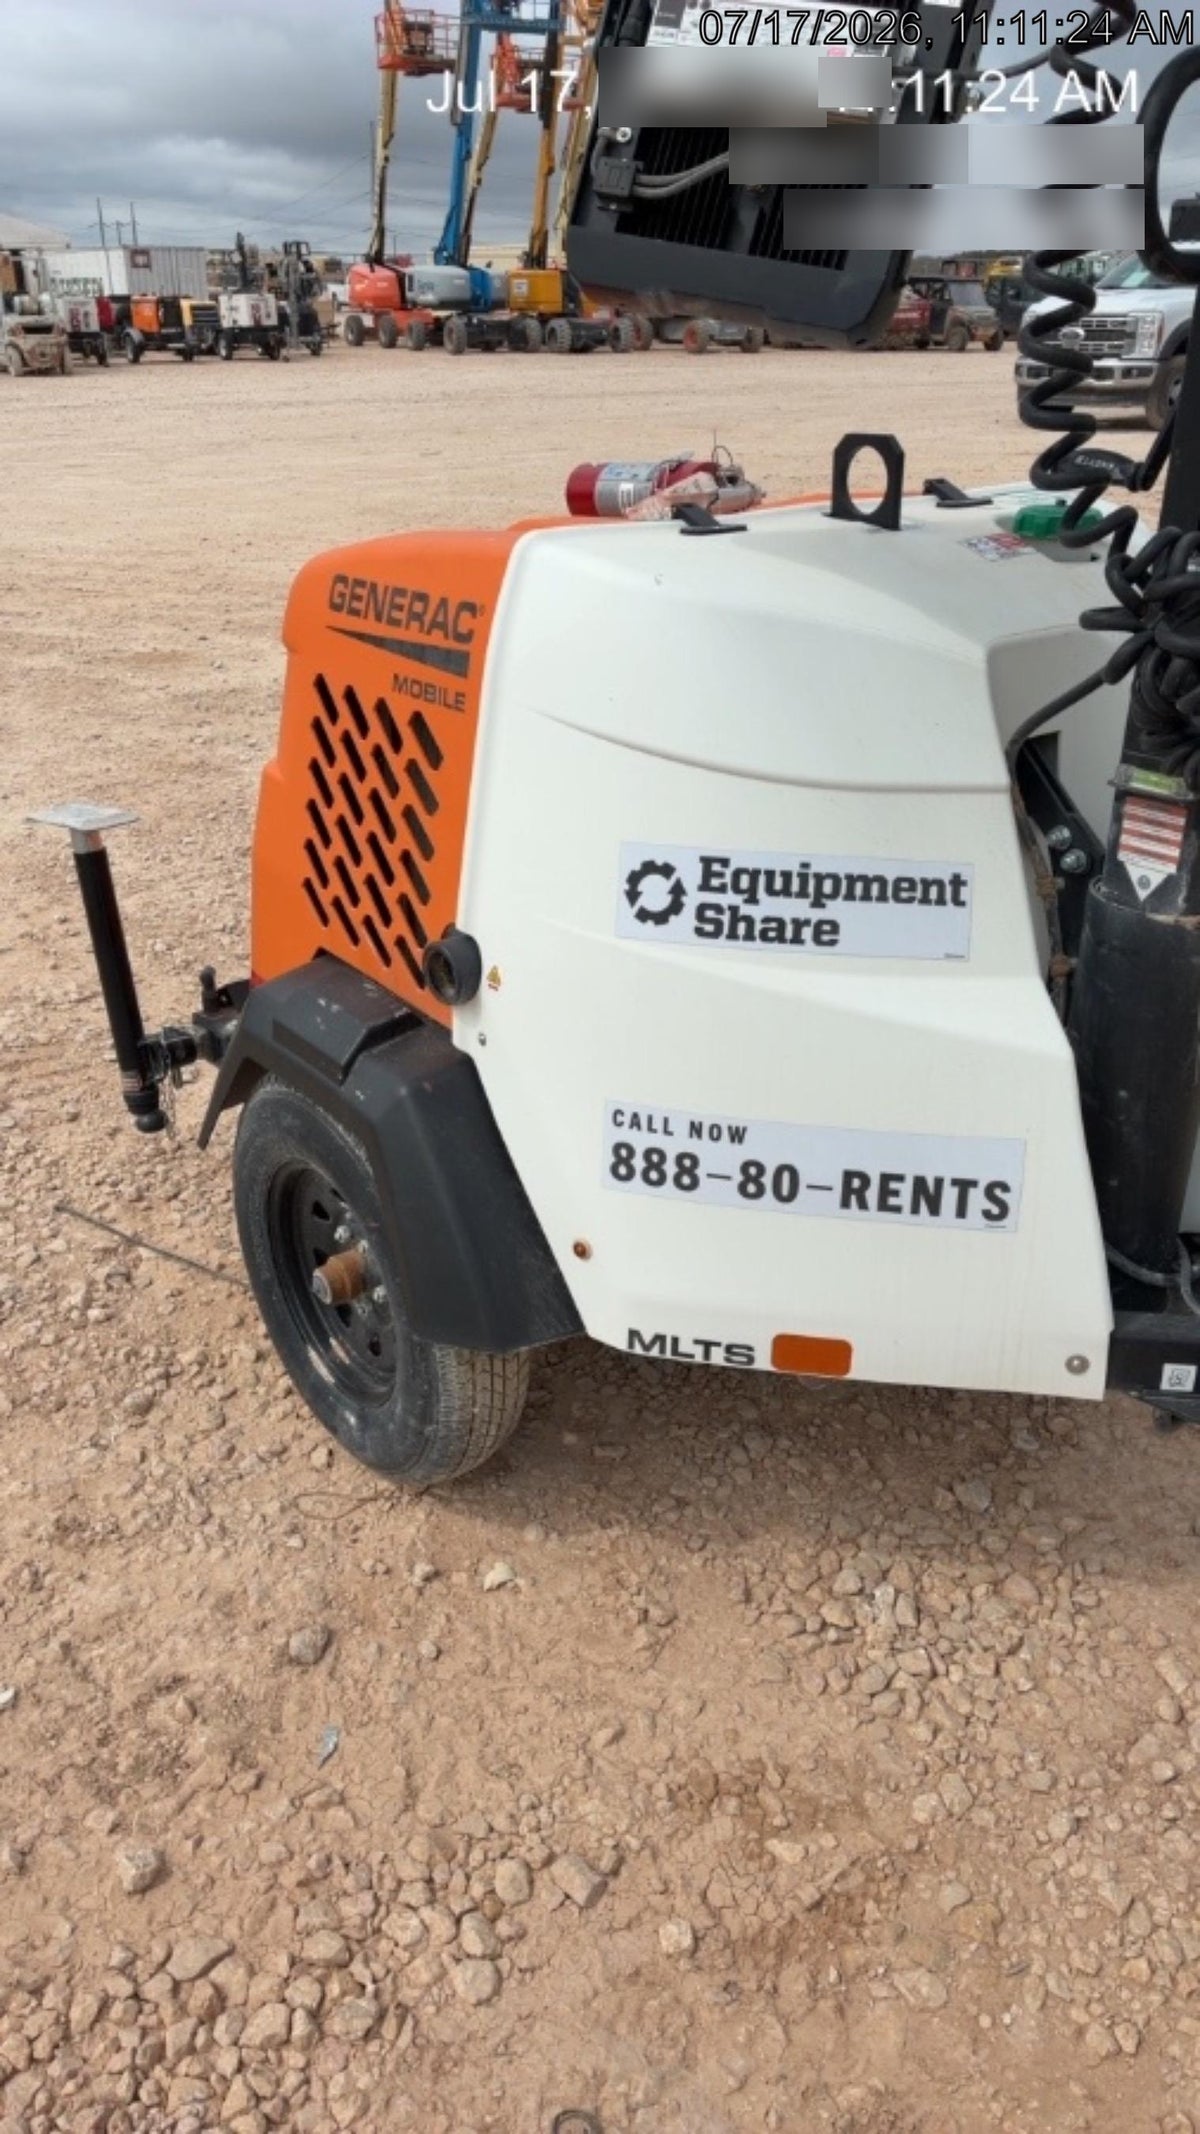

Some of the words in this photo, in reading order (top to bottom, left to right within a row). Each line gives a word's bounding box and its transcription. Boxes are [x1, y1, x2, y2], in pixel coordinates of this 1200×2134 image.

[329, 574, 478, 643] GENERAC
[392, 673, 466, 712] MOBILE
[697, 855, 968, 908] Equipment
[694, 901, 840, 947] Share
[612, 1108, 675, 1138] CALL
[689, 1120, 749, 1146] NOW
[626, 1327, 756, 1367] MLTS
